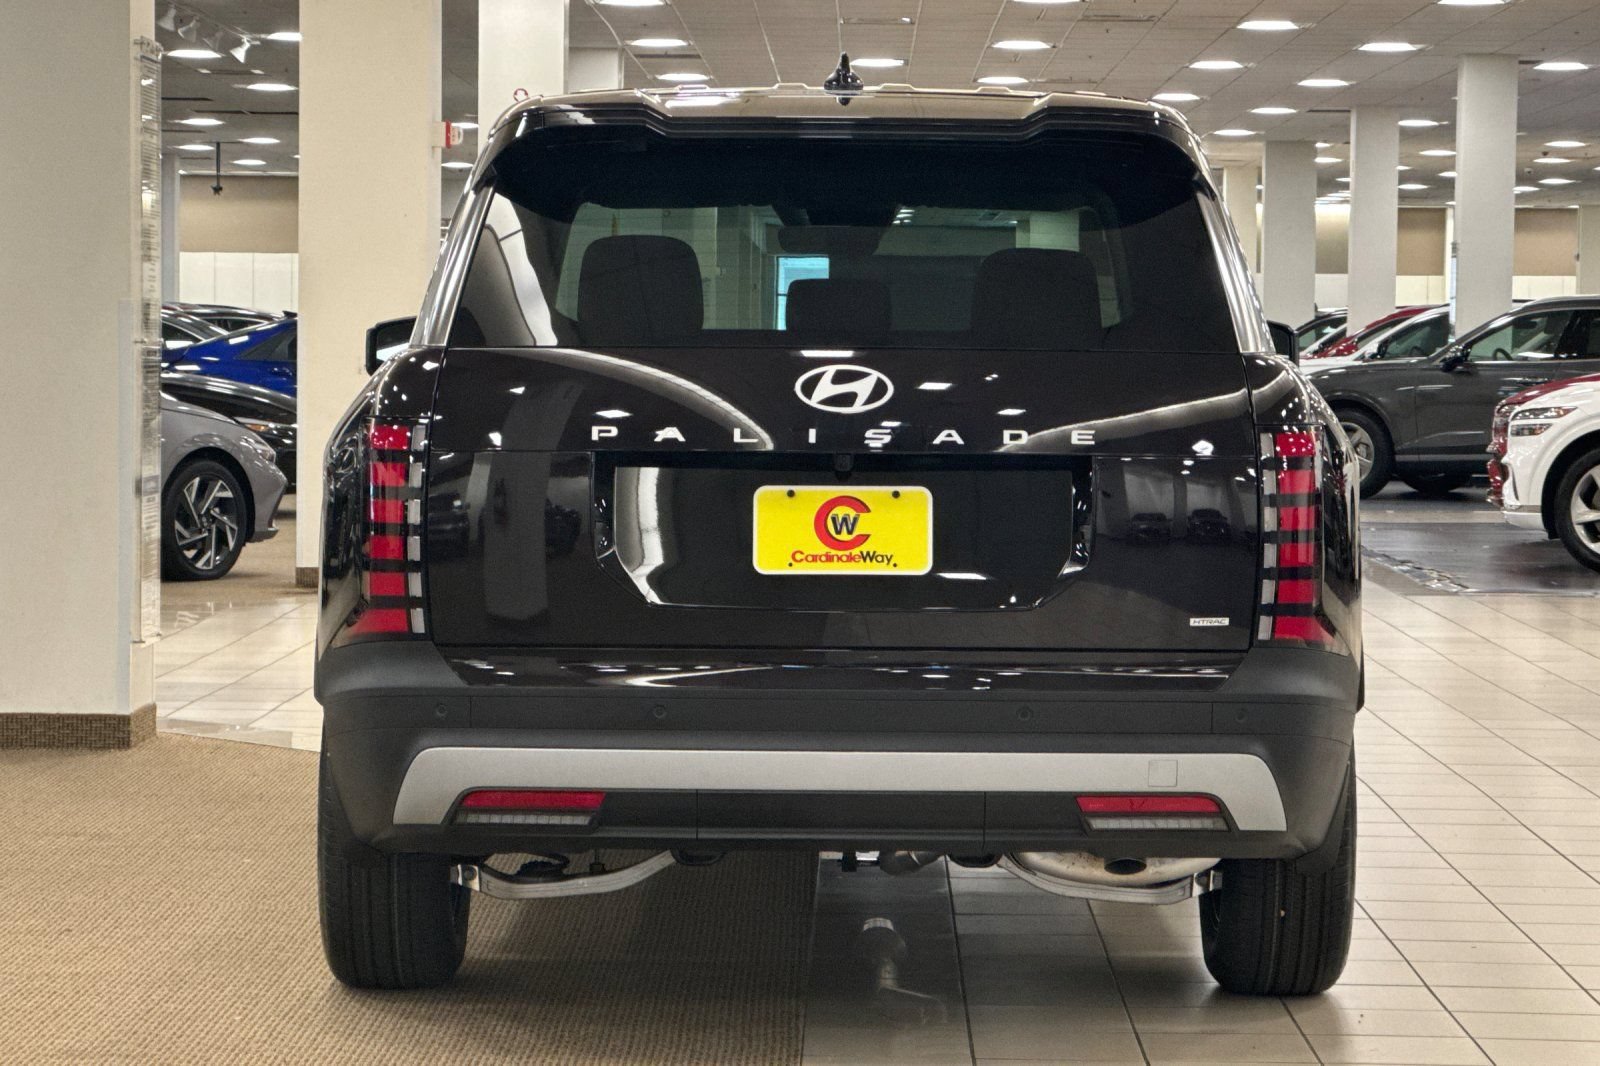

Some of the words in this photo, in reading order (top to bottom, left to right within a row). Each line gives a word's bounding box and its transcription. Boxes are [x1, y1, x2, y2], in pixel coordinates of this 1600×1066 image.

[591, 425, 1096, 446] PALISADE
[791, 550, 893, 565] CardinaleWay
[1191, 618, 1228, 626] HTRAC
